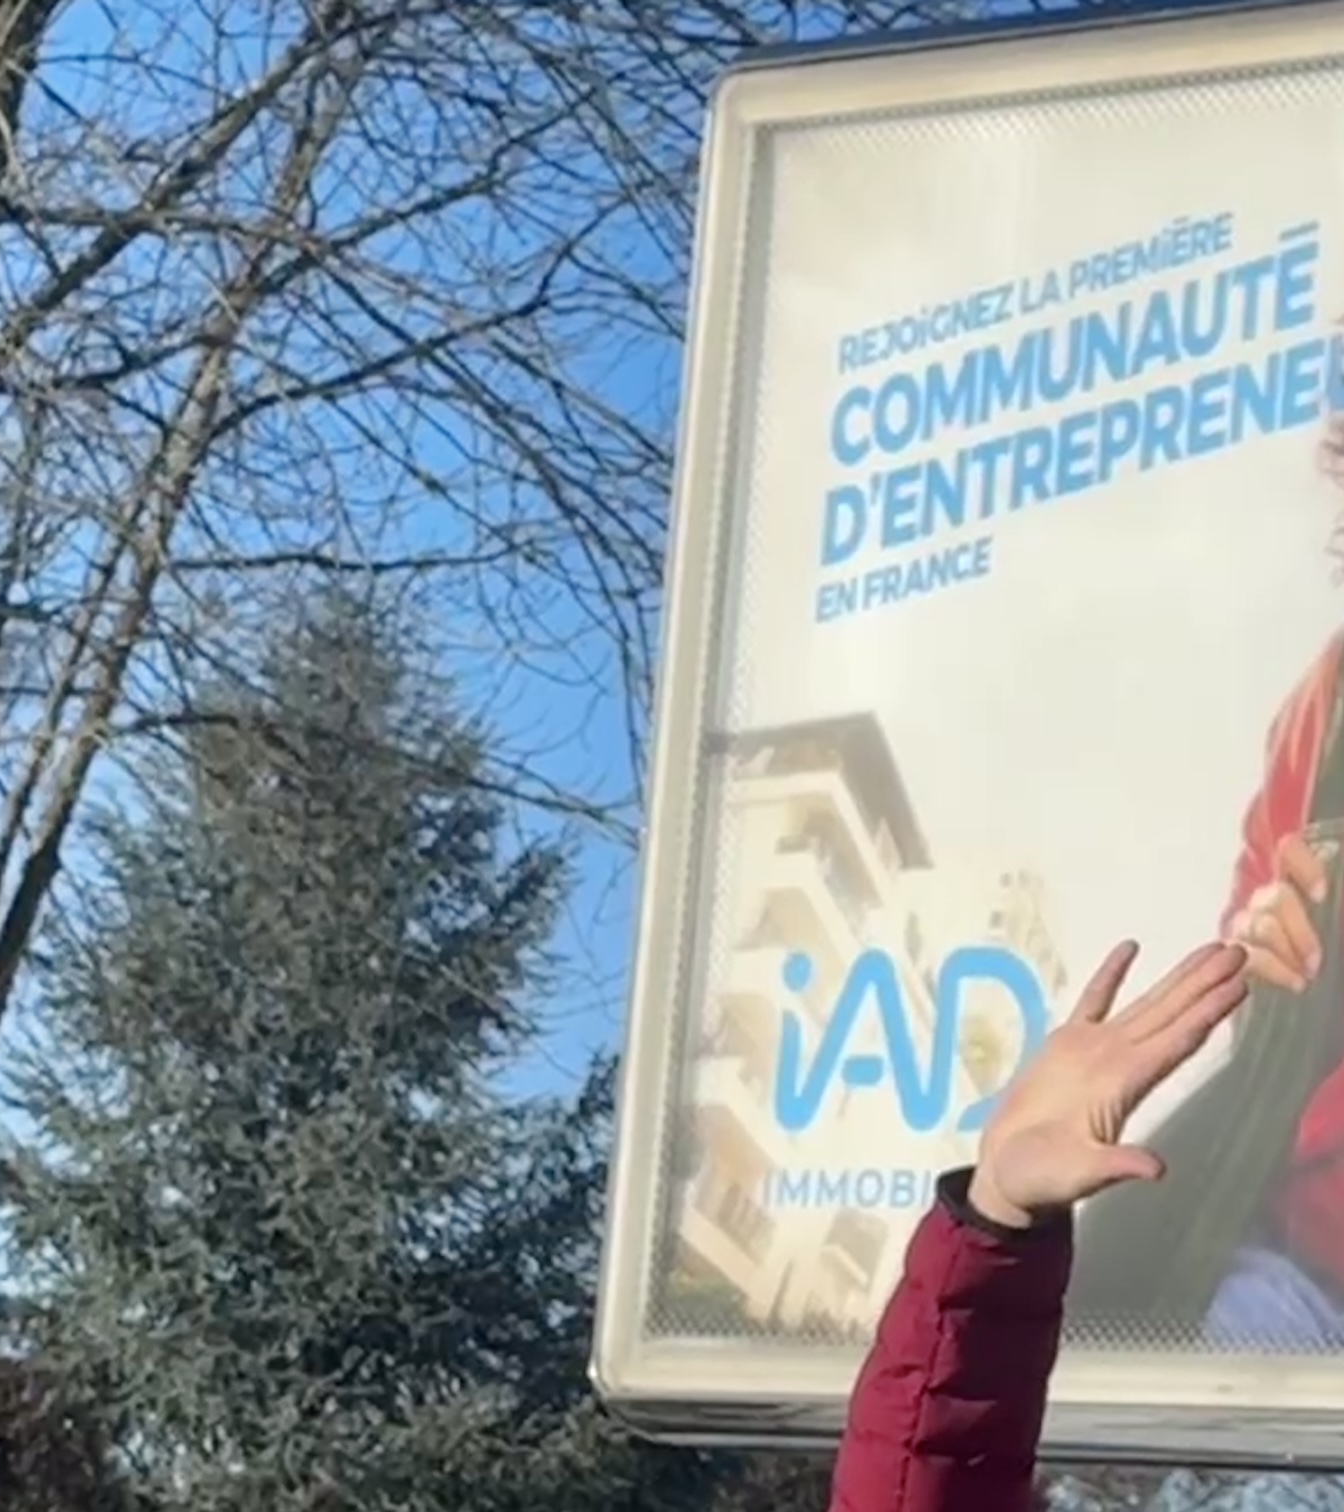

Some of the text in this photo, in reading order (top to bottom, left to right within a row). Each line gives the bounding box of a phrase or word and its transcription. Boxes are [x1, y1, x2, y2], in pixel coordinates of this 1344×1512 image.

[1019, 269, 1064, 316] LA
[830, 219, 1320, 467] COMMUNAUTÉ
[815, 532, 994, 624] EN FRANCE
[762, 1167, 933, 1210] IMMOBI
